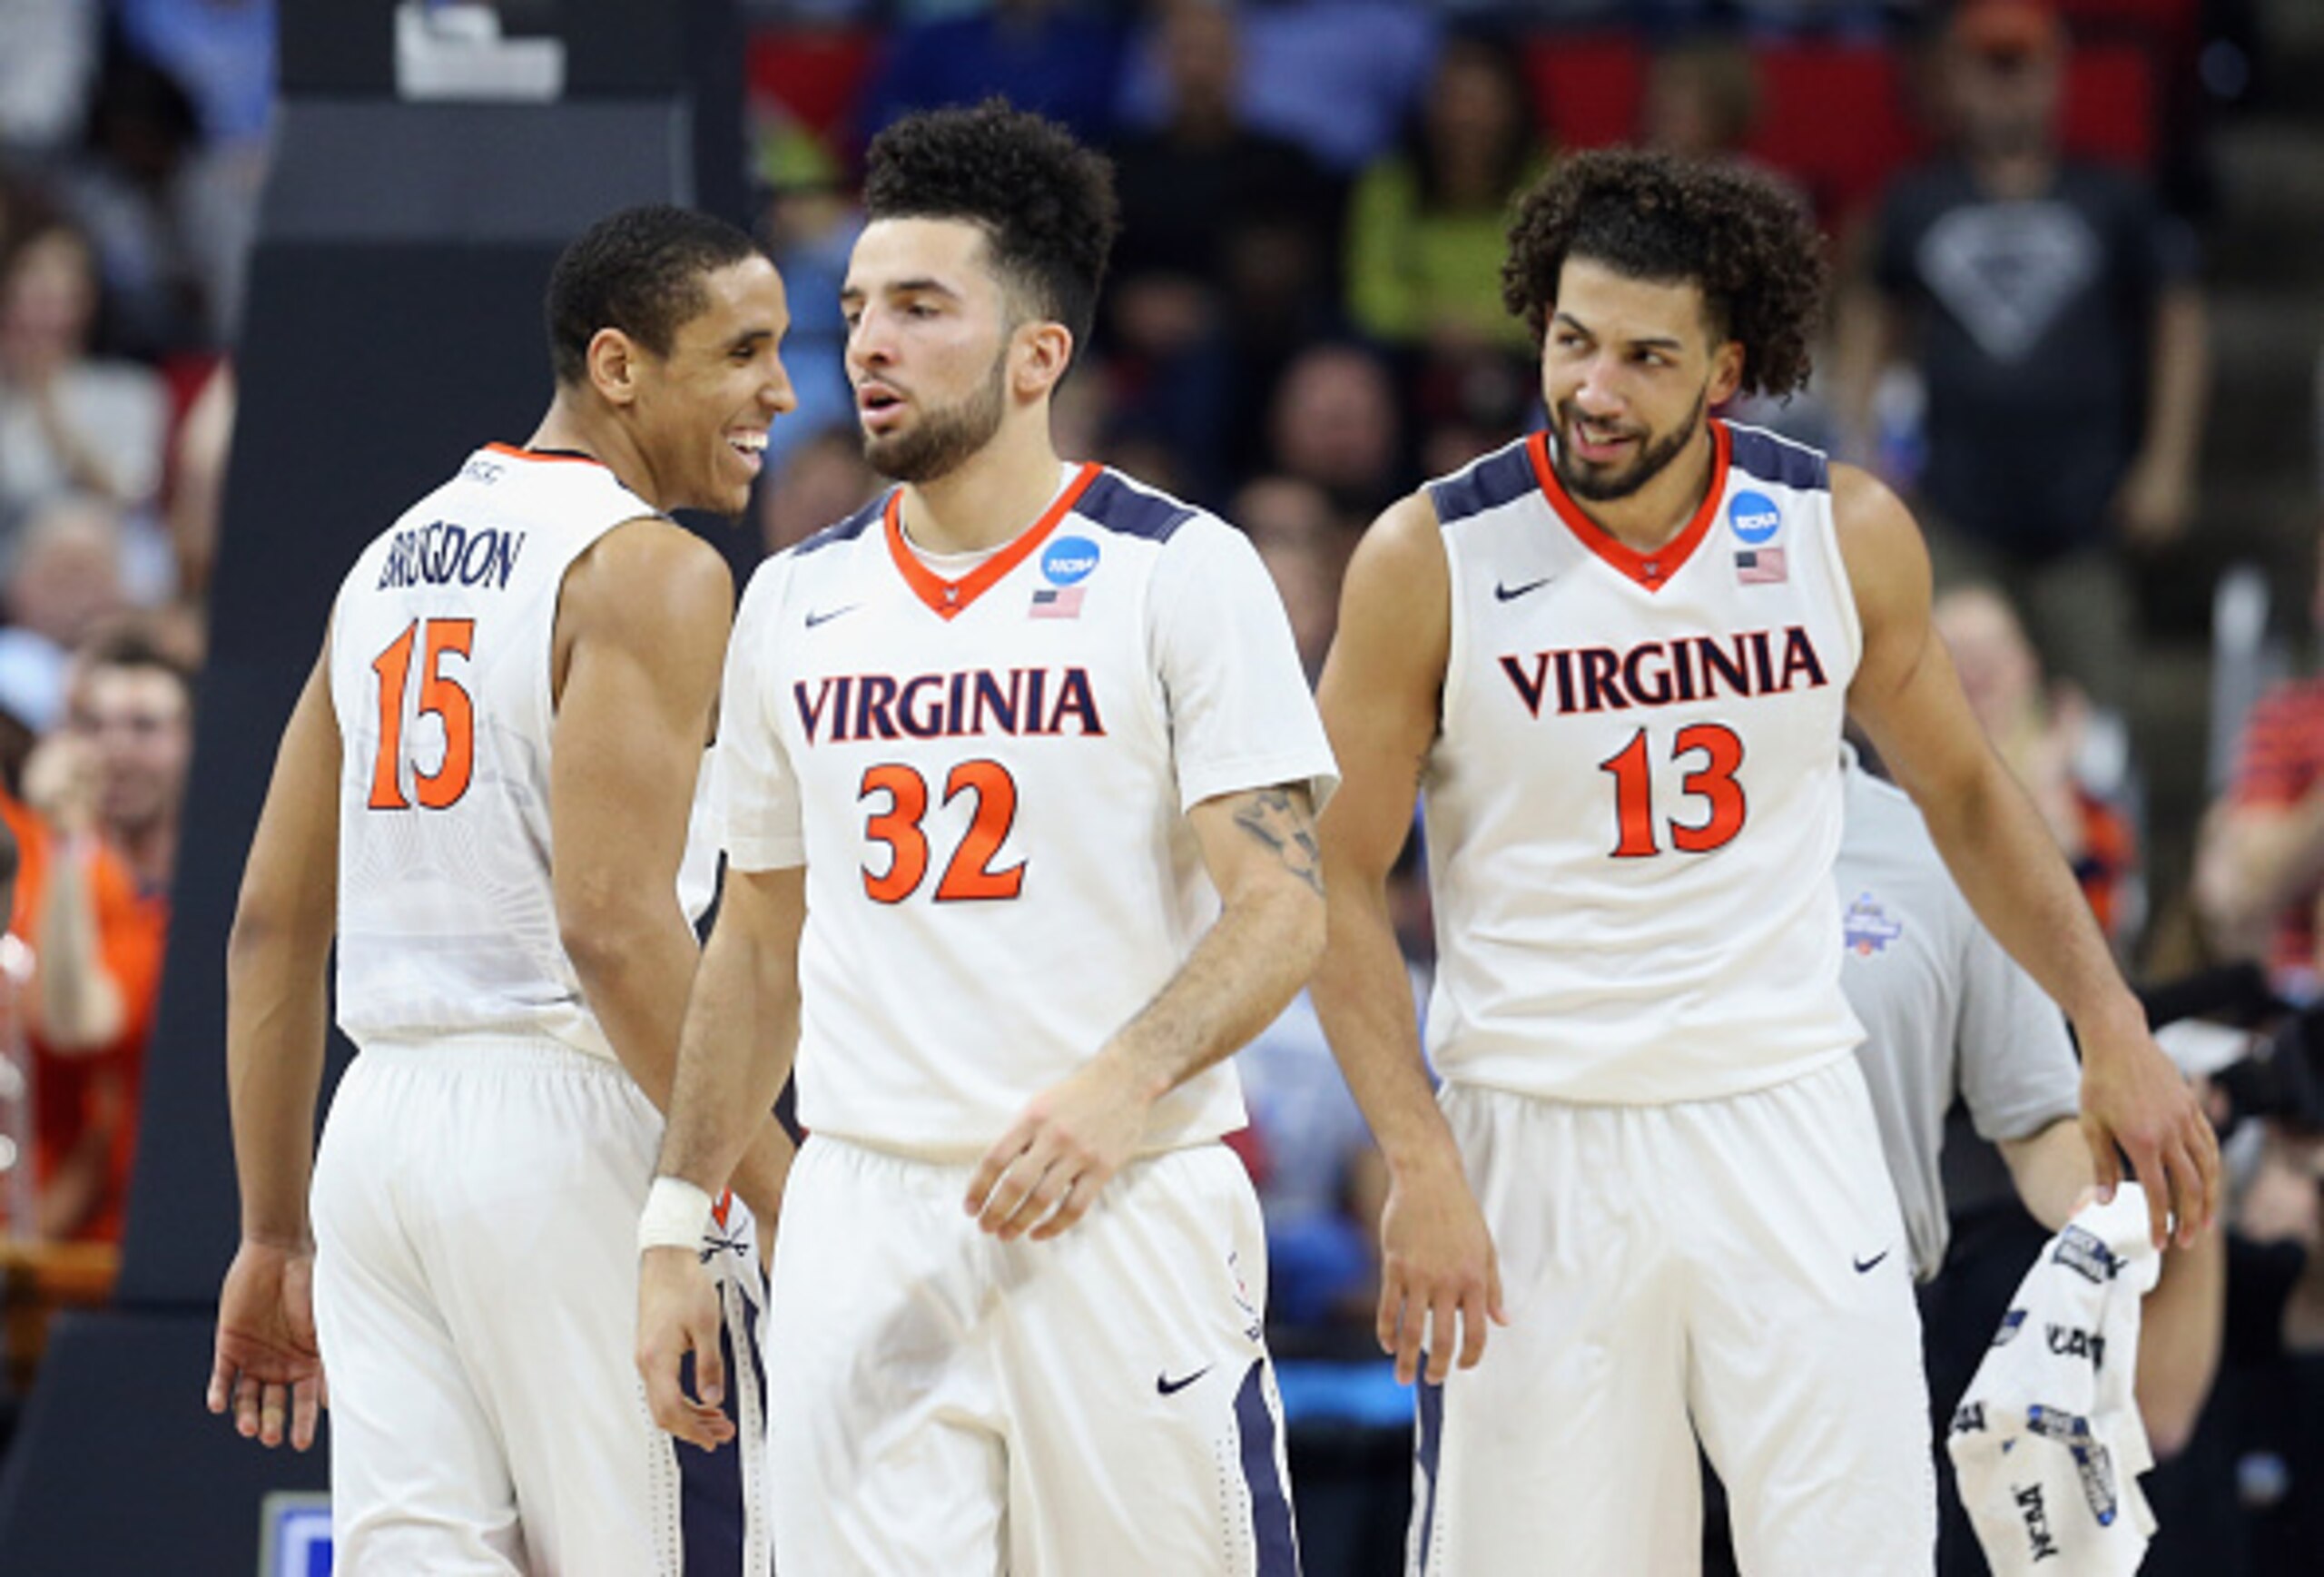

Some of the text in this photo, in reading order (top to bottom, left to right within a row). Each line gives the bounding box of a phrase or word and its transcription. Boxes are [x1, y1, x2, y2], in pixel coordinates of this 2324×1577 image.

[368, 617, 476, 810] 15
[793, 667, 1108, 747] VIRGINIA
[1498, 626, 1828, 720] VIRGINIA
[857, 758, 1028, 904] 32
[1599, 723, 1748, 858] 13
